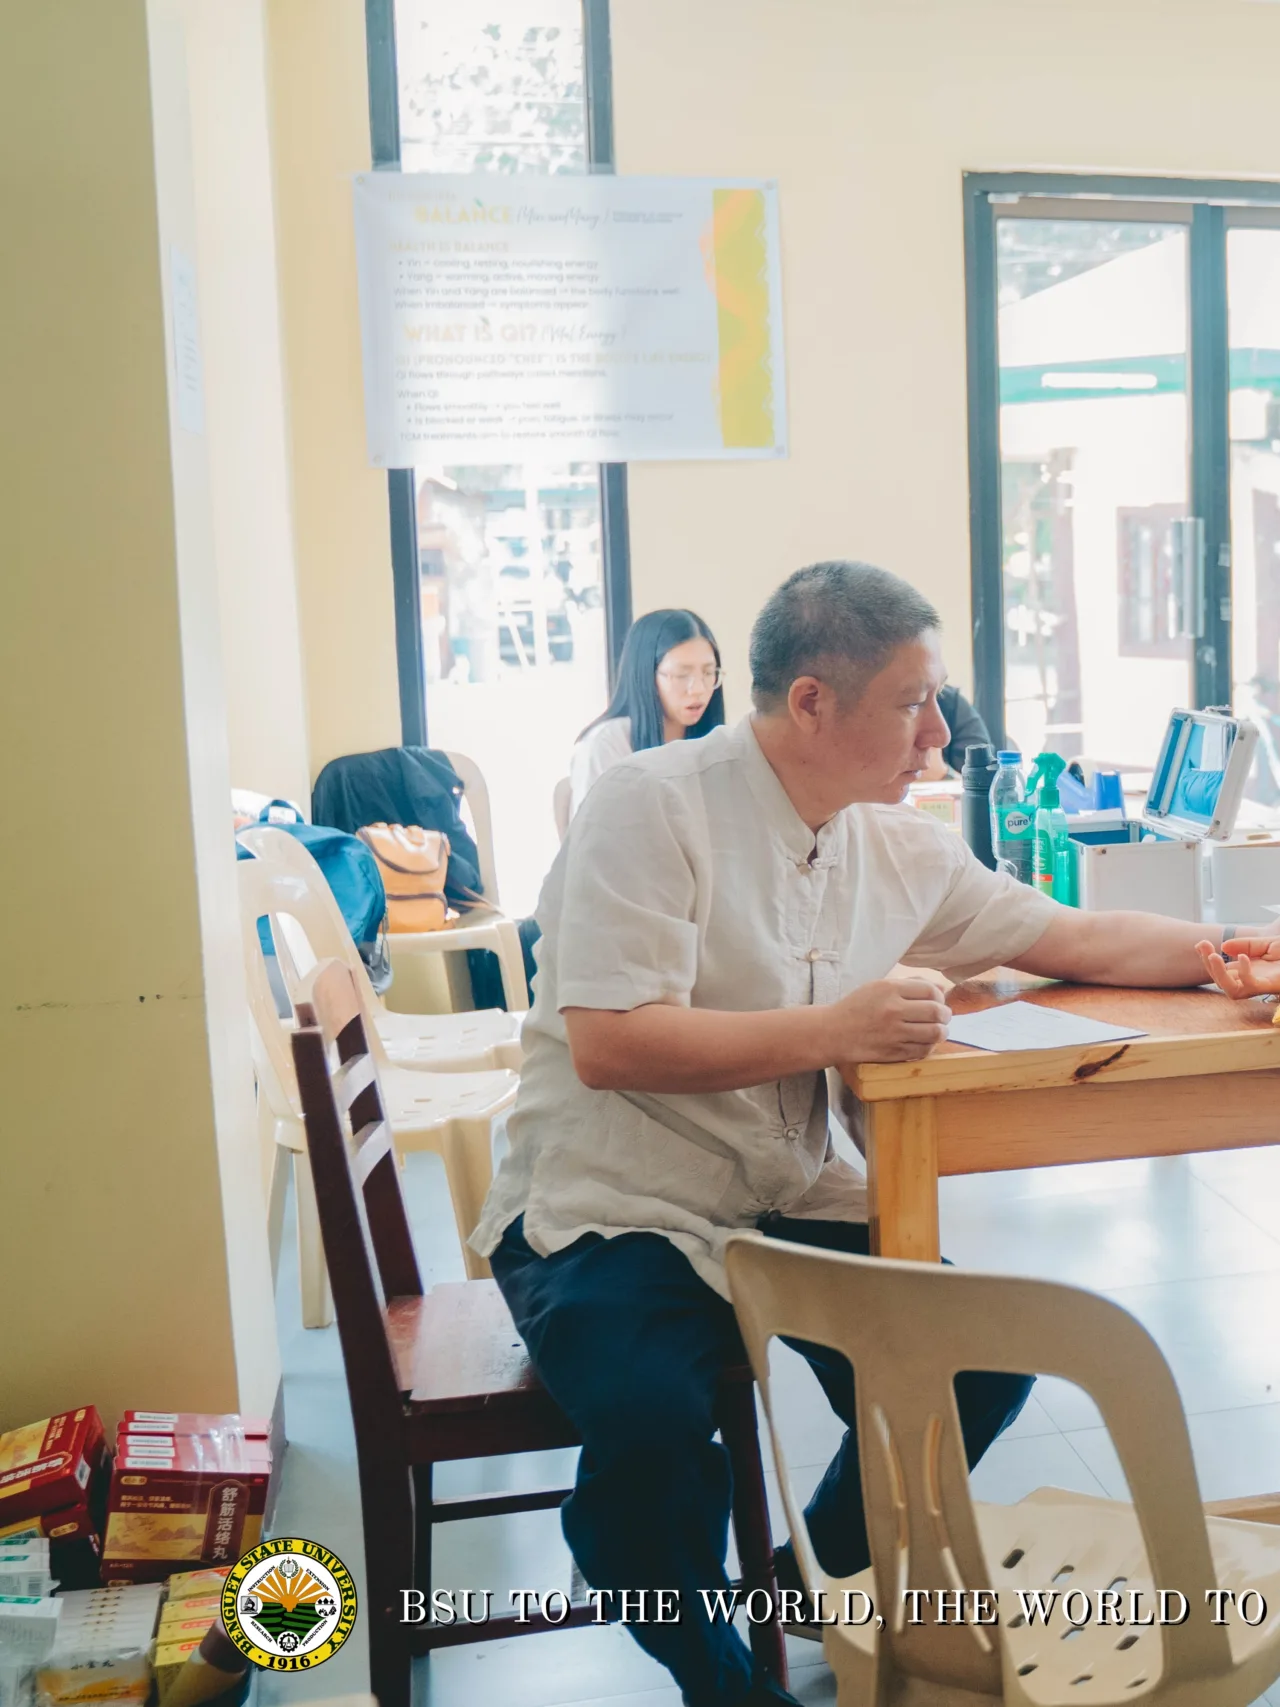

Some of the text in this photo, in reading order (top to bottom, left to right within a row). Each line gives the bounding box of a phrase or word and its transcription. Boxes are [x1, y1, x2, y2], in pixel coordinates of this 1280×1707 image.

[414, 204, 511, 225] BALANCE
[454, 240, 509, 254] BALANCE
[405, 258, 422, 267] Yin
[565, 260, 599, 270] energy
[407, 272, 433, 283] Yang
[526, 273, 564, 283] moving
[566, 273, 600, 283] energy
[394, 286, 422, 296] When
[424, 287, 439, 295] Yin
[441, 286, 461, 295] and
[464, 286, 489, 298] Yang
[491, 288, 507, 296] are
[394, 300, 423, 309] When
[403, 323, 468, 342] WHAT
[474, 321, 493, 341] IS
[499, 322, 537, 342] QI?
[1007, 818, 1029, 828] pure
[212, 1487, 238, 1559] 舒筋活络丸
